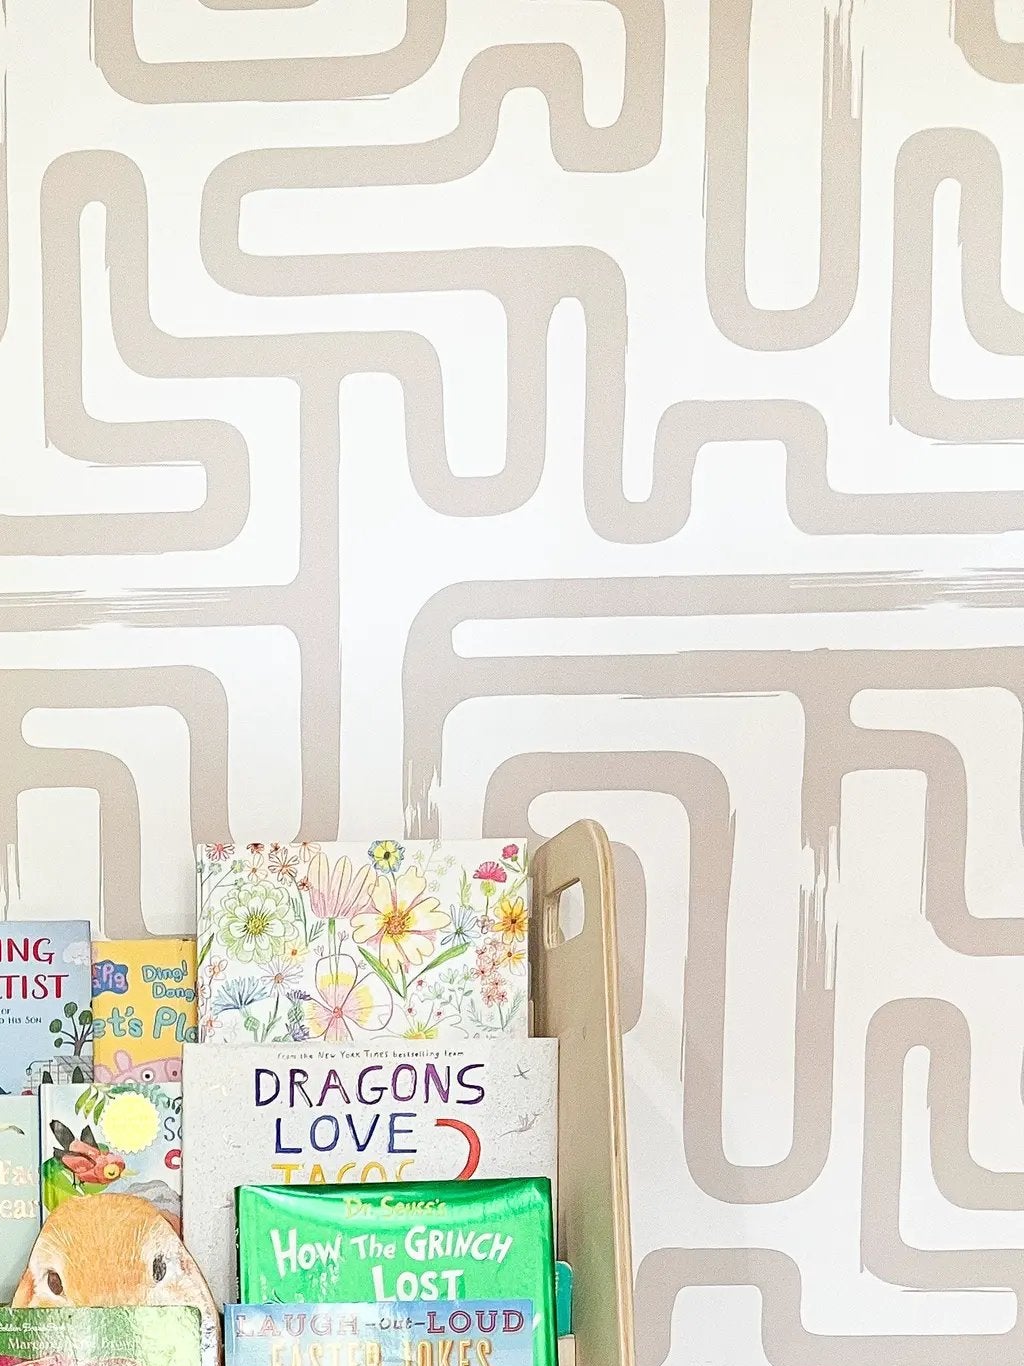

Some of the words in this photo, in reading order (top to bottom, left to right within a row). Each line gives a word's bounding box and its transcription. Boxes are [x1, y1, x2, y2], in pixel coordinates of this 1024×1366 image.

[254, 1063, 485, 1108] DRAGONS
[275, 1112, 417, 1154] LOVE
[404, 1225, 513, 1264] GRINCH
